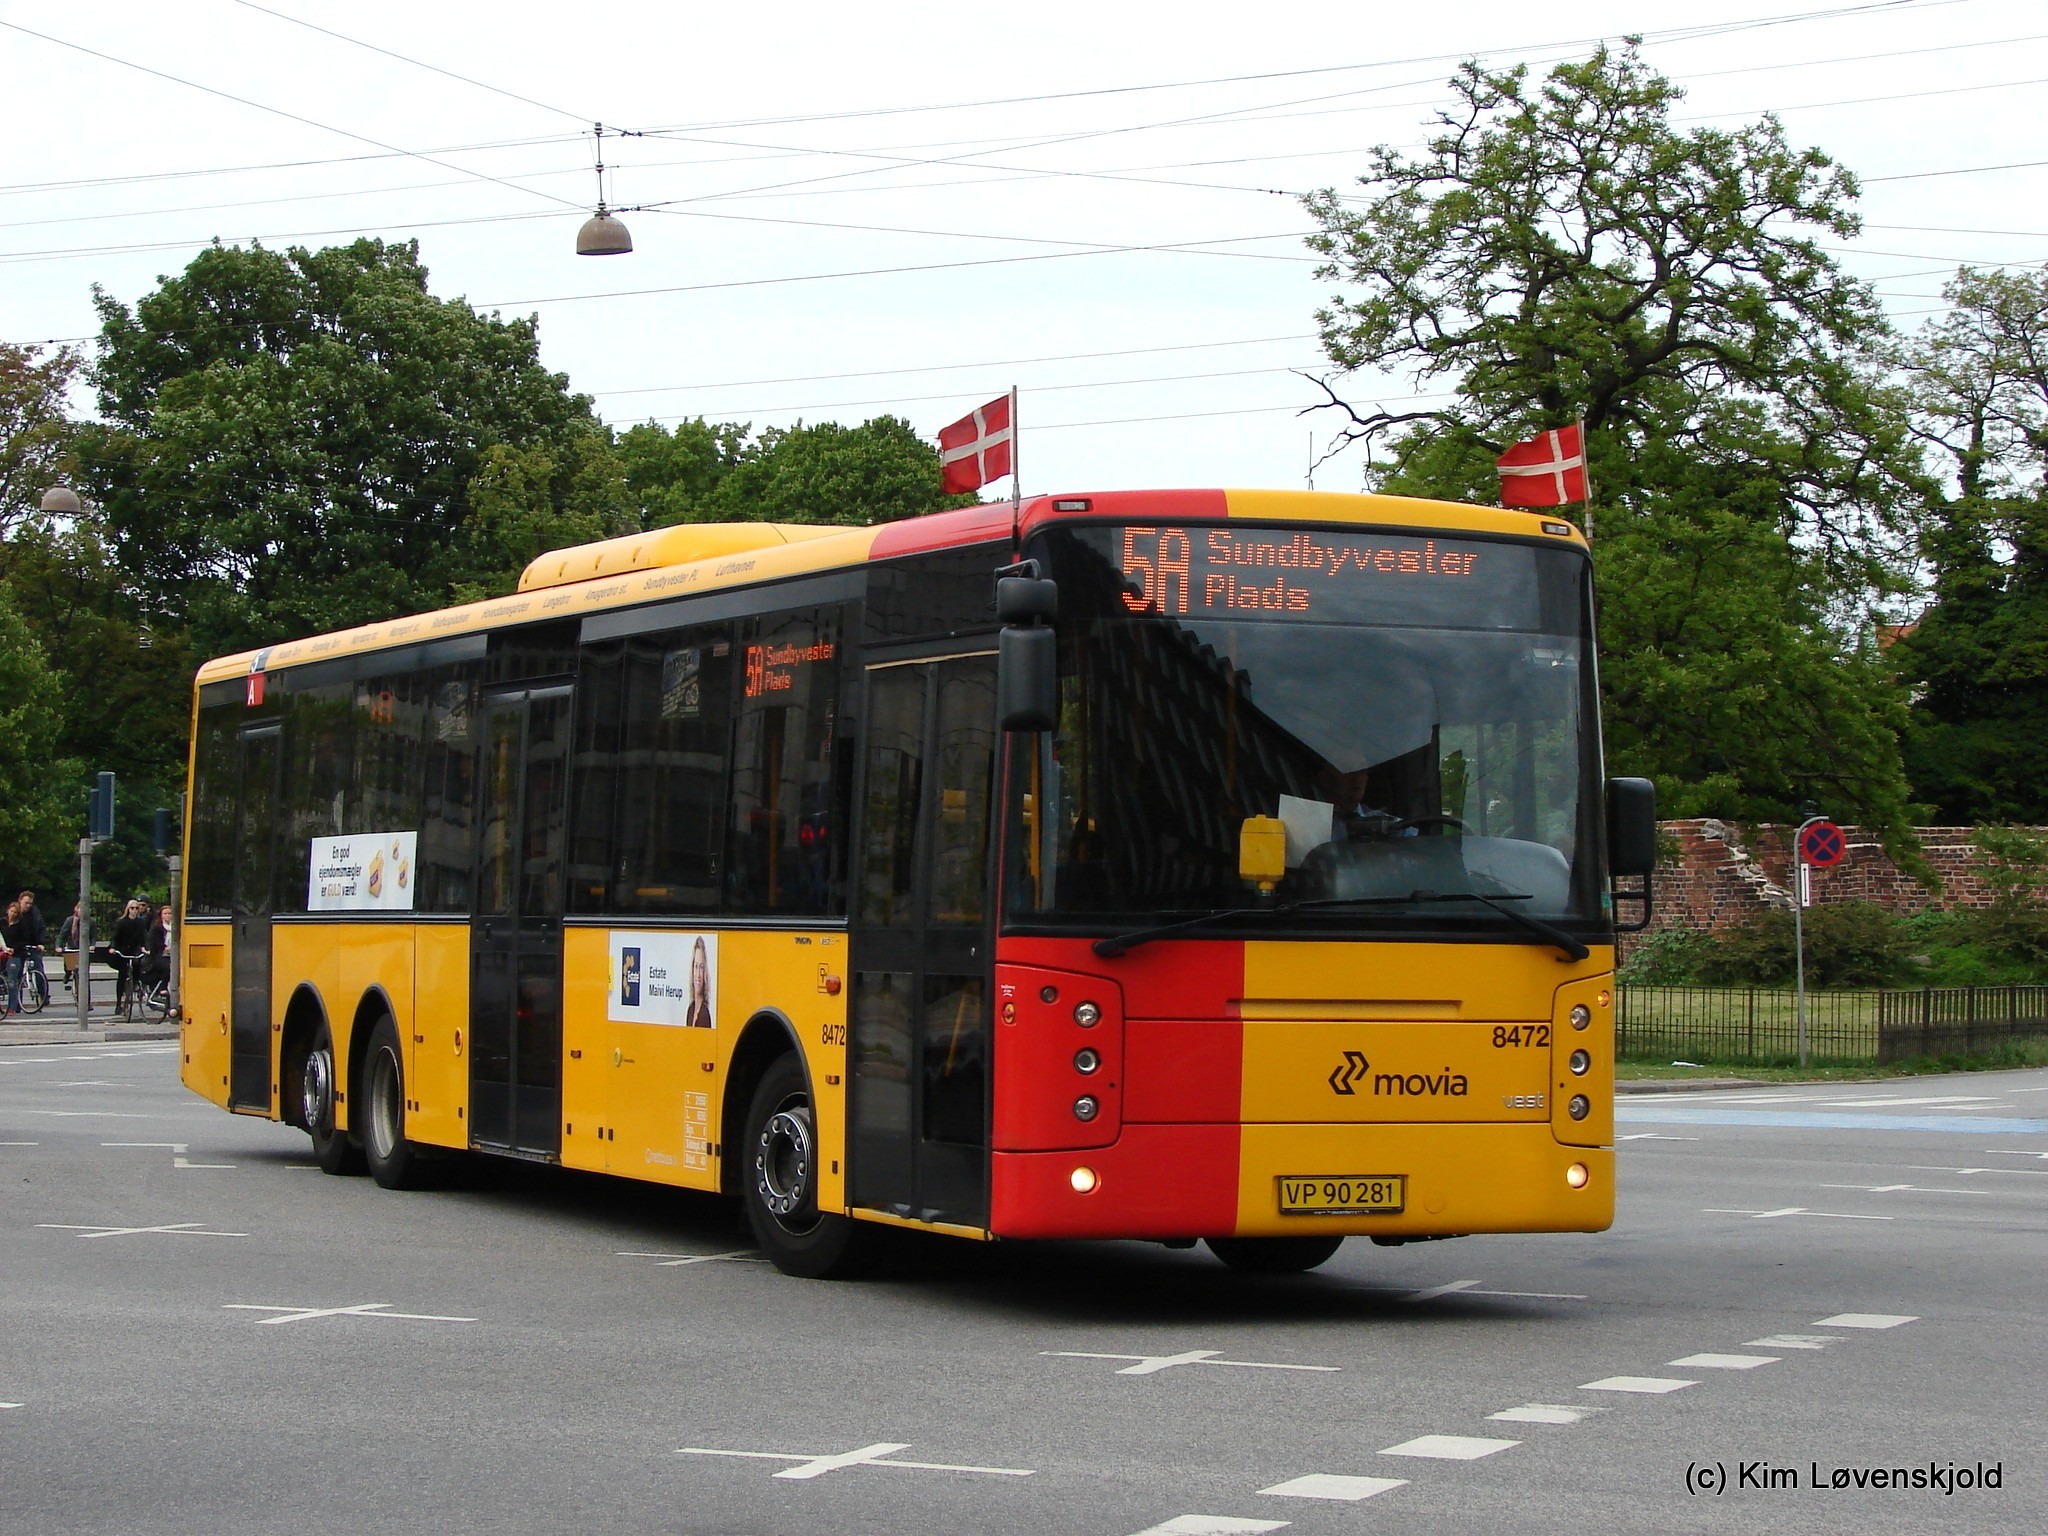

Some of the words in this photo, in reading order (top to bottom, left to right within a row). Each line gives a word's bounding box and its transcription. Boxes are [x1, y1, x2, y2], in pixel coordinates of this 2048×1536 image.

[1207, 530, 1478, 576] Sundbyvester
[1122, 526, 1190, 613] 5A
[1205, 573, 1310, 611] Plads
[766, 639, 834, 667] Sundbyvester
[745, 645, 764, 697] 5A
[765, 669, 791, 691] Plads
[332, 845, 339, 859] En
[340, 843, 350, 862] god
[649, 966, 667, 980] Estate
[649, 983, 664, 998] Maivi
[665, 985, 683, 1001] Herup
[822, 1023, 845, 1046] 8472
[1492, 1025, 1550, 1048] 8472
[1373, 1066, 1468, 1096] movia
[1502, 1092, 1544, 1109] vest
[1285, 1183, 1317, 1204] VP
[1323, 1182, 1351, 1204] 90
[1355, 1182, 1392, 1203] 281
